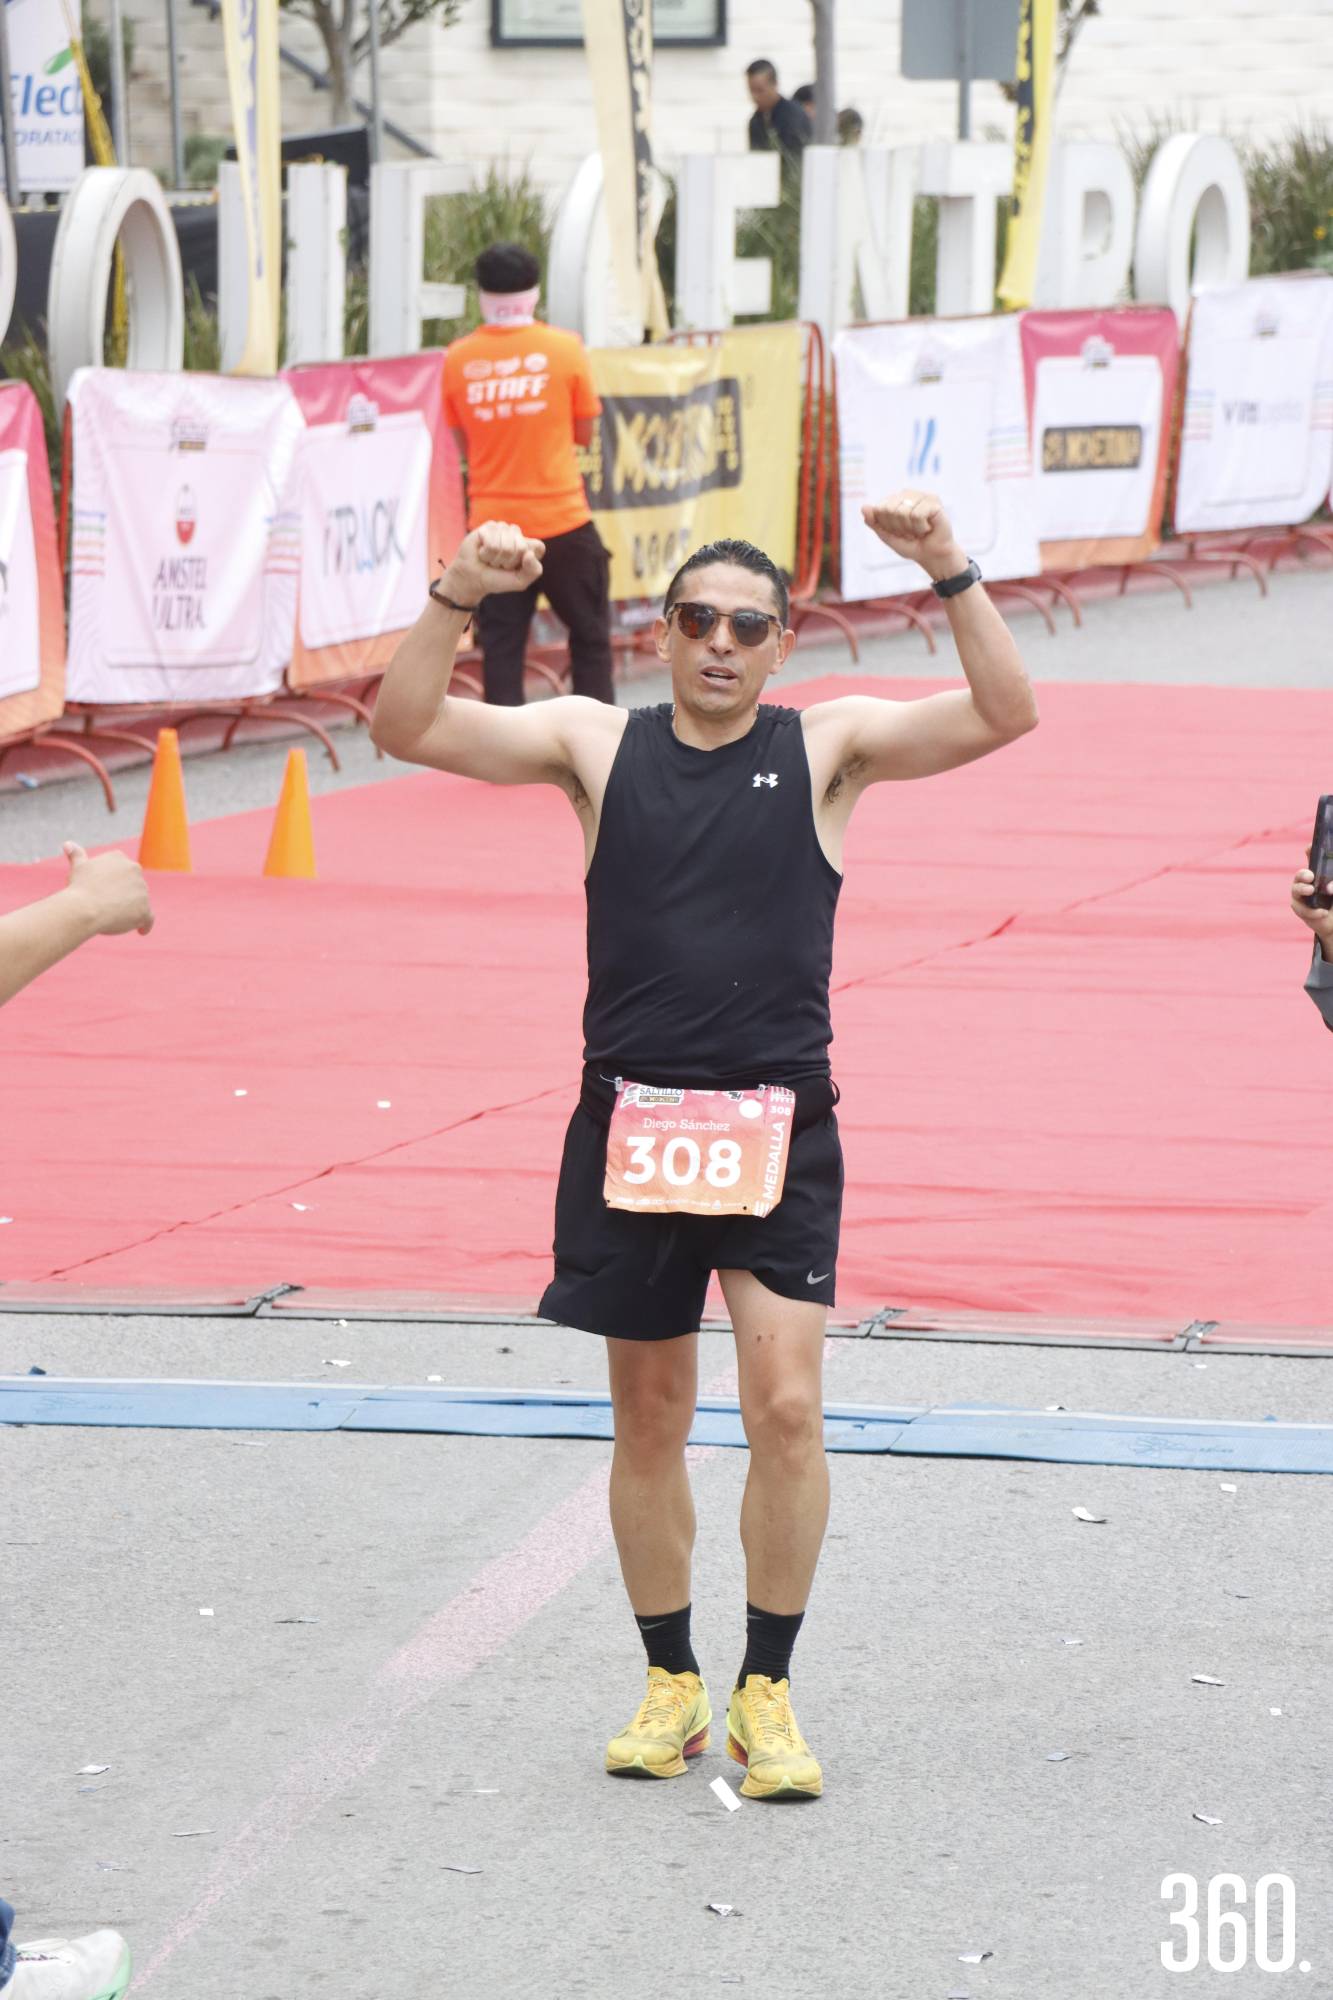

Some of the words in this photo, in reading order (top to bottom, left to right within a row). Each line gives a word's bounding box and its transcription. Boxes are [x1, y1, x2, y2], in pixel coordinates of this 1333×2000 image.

[467, 373, 549, 404] STAFF
[153, 556, 207, 589] AMSTEL
[642, 1117, 677, 1132] Diego
[680, 1118, 731, 1132] Sánchez
[623, 1136, 743, 1188] 308
[762, 1121, 786, 1201] MEDALLA
